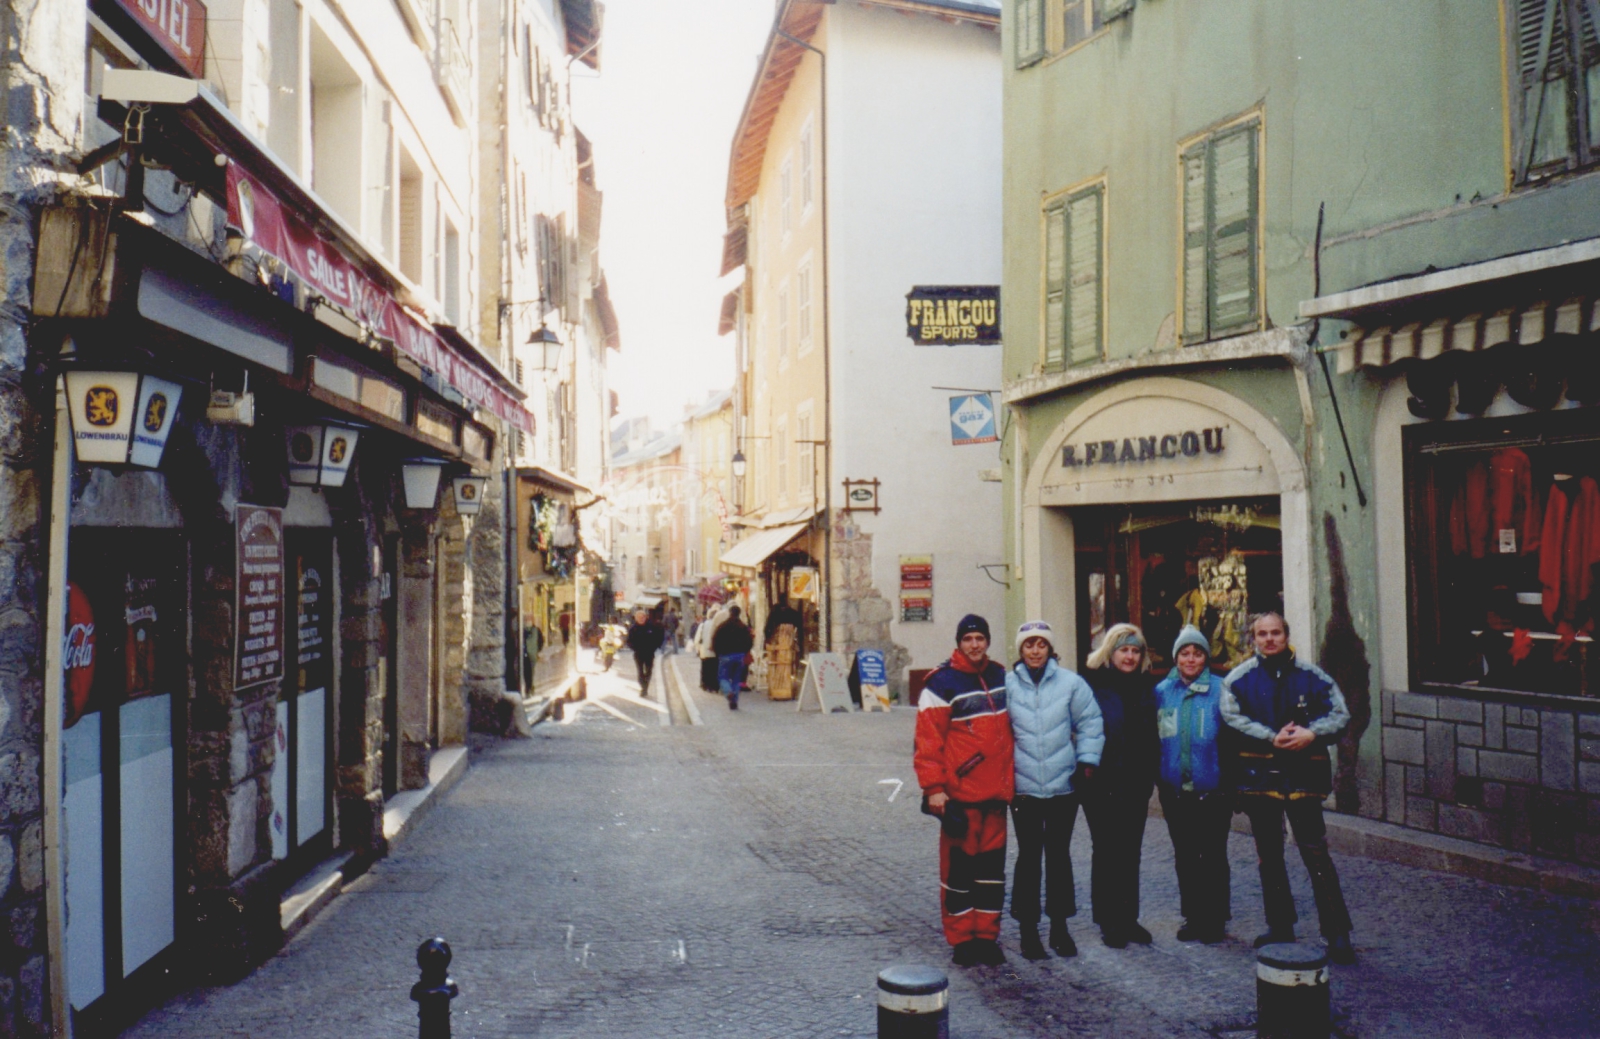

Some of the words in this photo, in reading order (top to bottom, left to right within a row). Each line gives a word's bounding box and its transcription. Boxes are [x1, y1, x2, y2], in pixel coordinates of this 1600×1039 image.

[137, 0, 192, 56] TEL
[307, 248, 348, 299] SALLE
[909, 299, 996, 326] FRANCOU
[921, 325, 978, 340] SPORTS
[959, 413, 984, 424] gaz
